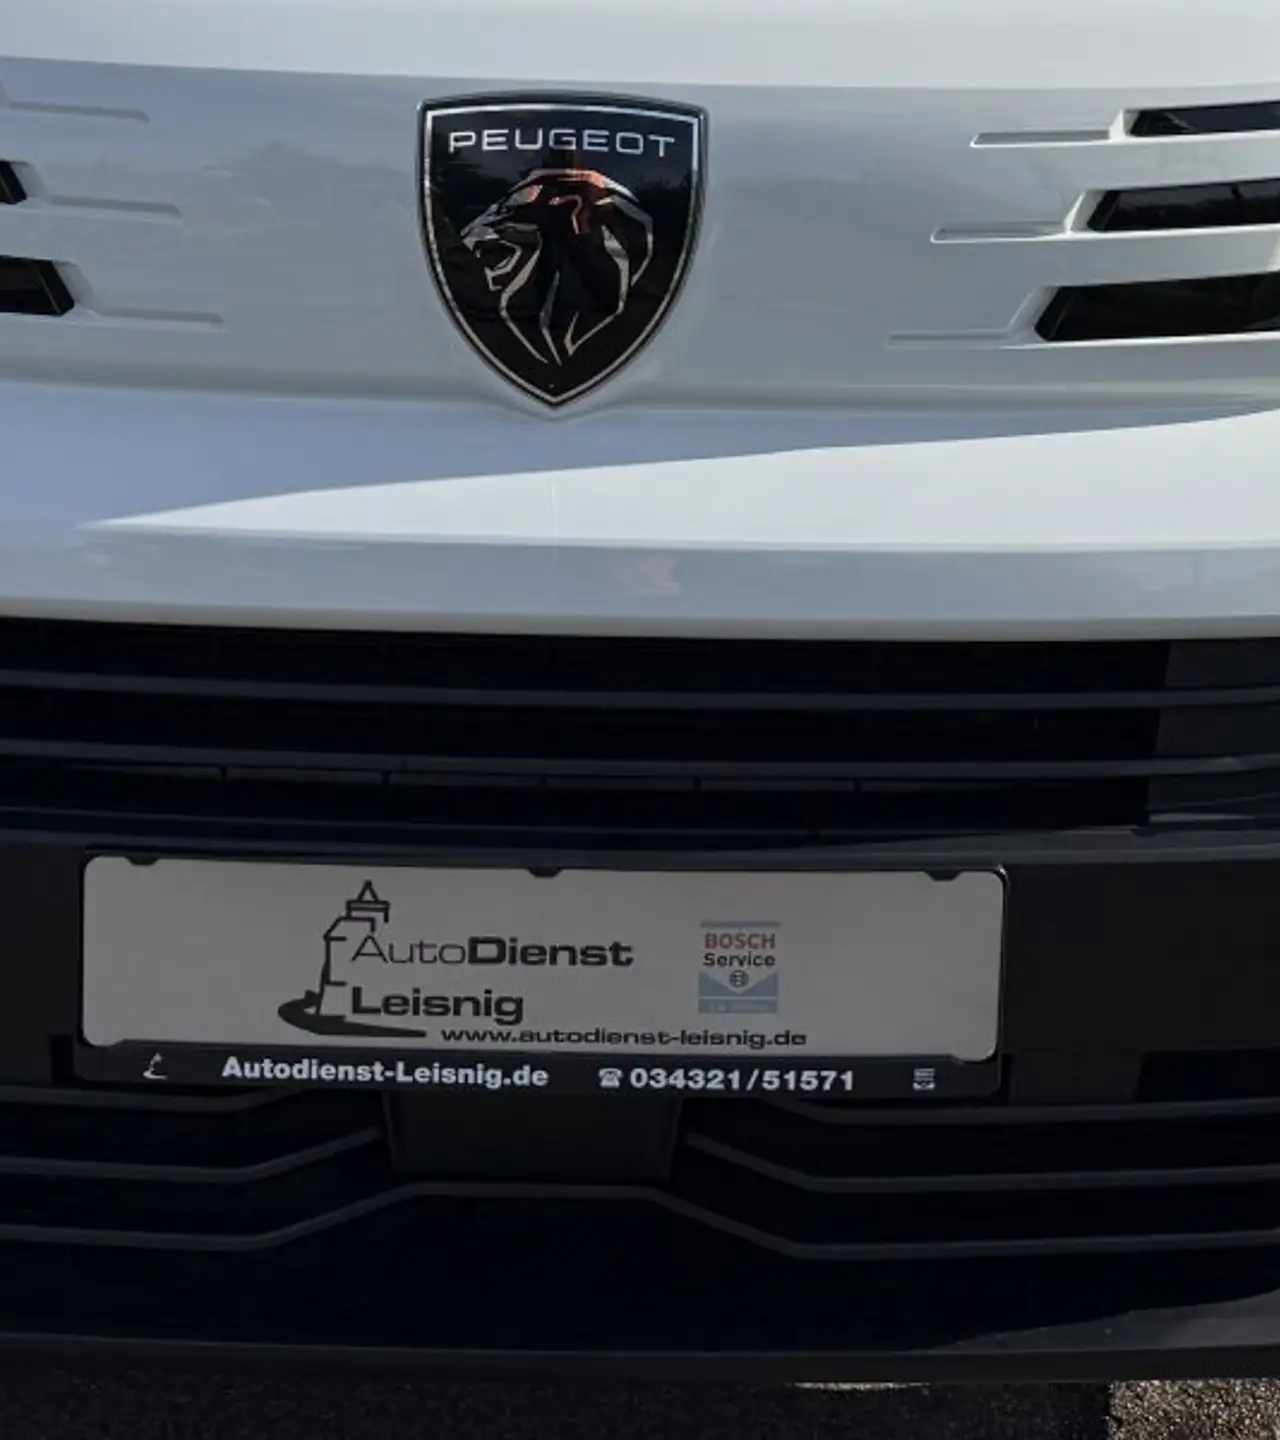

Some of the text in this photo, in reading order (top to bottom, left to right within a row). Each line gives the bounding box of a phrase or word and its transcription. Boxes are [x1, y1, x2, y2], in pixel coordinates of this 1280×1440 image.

[448, 127, 676, 158] PEUGEOT
[351, 934, 635, 967] AutoDienst
[703, 932, 776, 950] BOSCH
[702, 951, 776, 967] Service
[351, 985, 524, 1026] Leisnig
[440, 1027, 808, 1050] www.autodienst-leisnig.de
[221, 1056, 854, 1092] Autodienst-Leisnig.de 034321/51571
